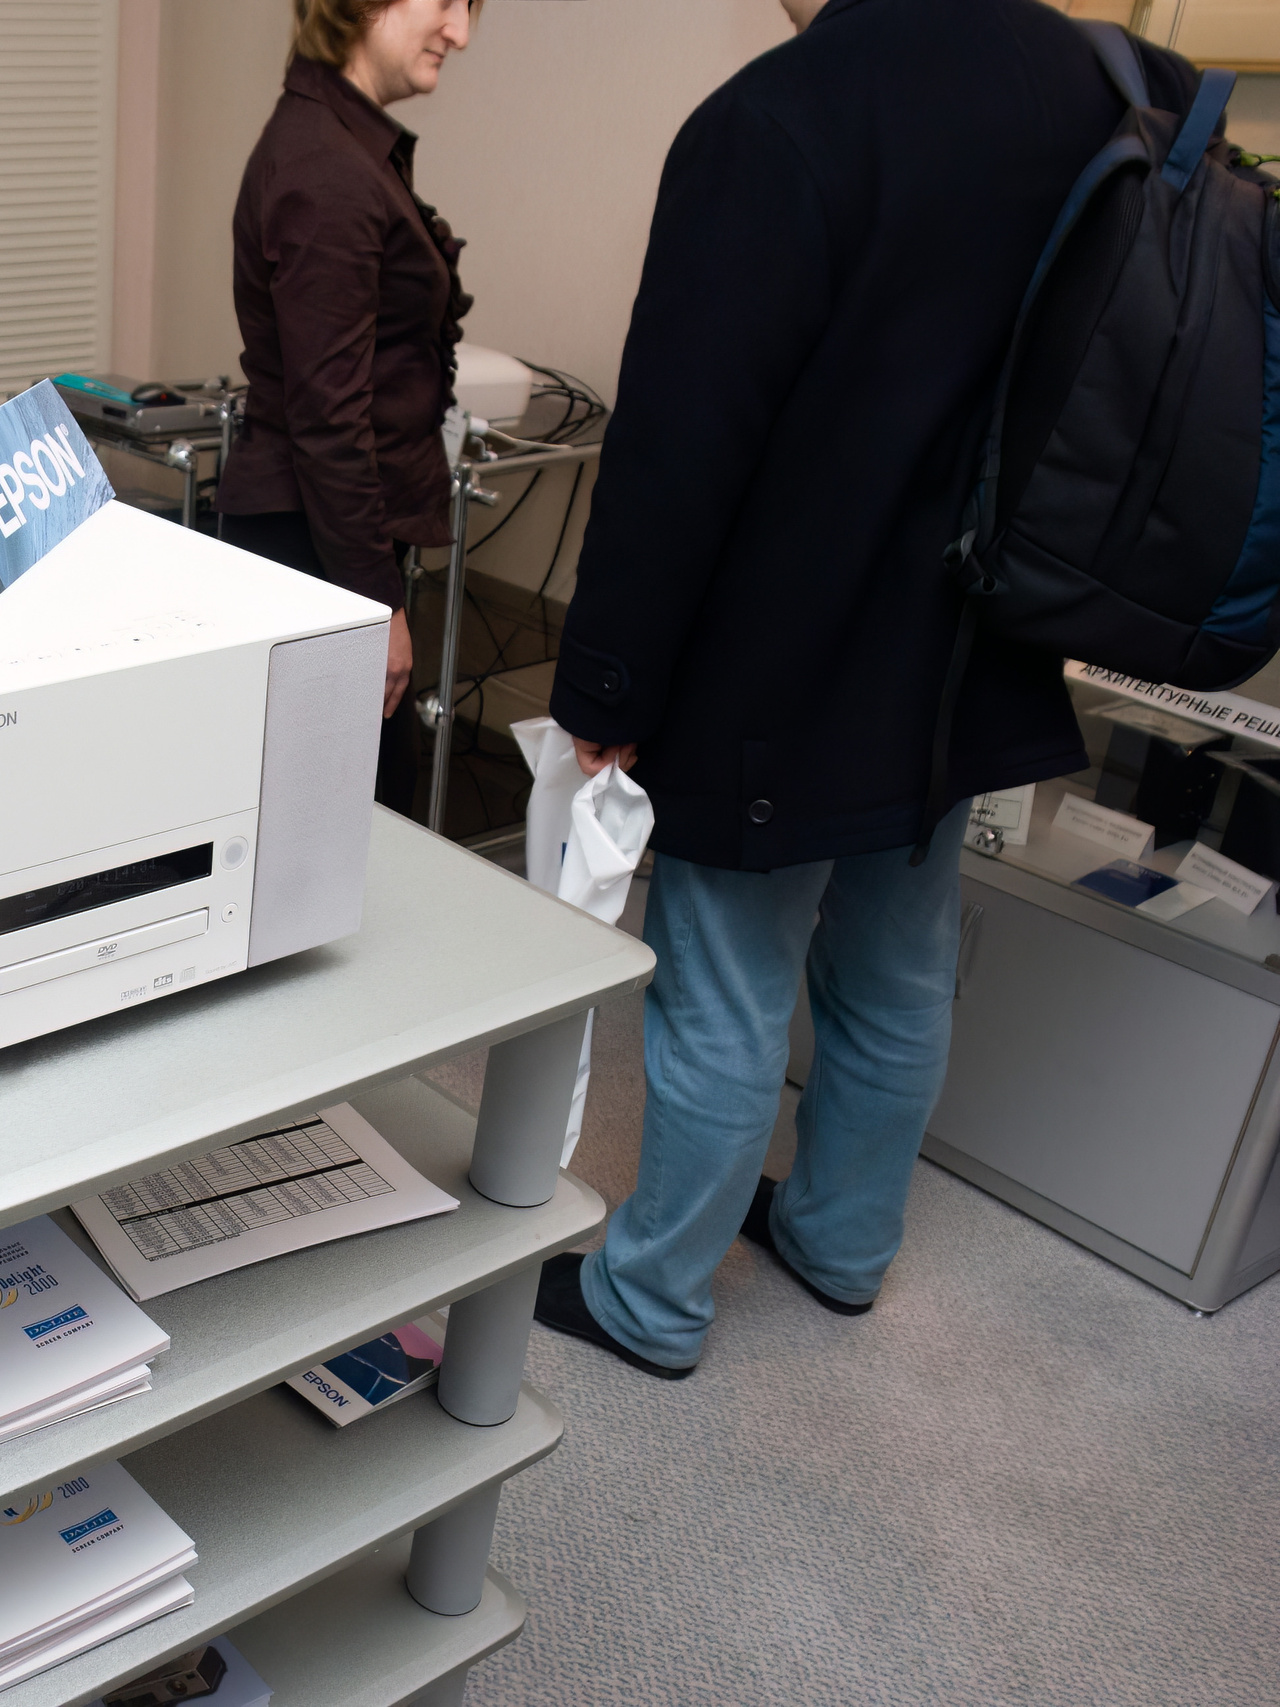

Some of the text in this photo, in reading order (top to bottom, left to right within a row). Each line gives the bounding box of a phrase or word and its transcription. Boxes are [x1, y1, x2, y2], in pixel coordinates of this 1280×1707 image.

[1080, 663, 1233, 722] АРХИТЕКТУРНЫЕ
[97, 943, 118, 954] DVD
[24, 1274, 59, 1296] 2000
[28, 1308, 84, 1337] DA-LITE
[35, 1320, 95, 1349] SCREEN COMPANY
[302, 1370, 349, 1407] EPSON
[57, 1476, 90, 1499] 2000
[64, 1511, 115, 1540] DA-LITE
[71, 1524, 125, 1554] SCREEN COMPANY
